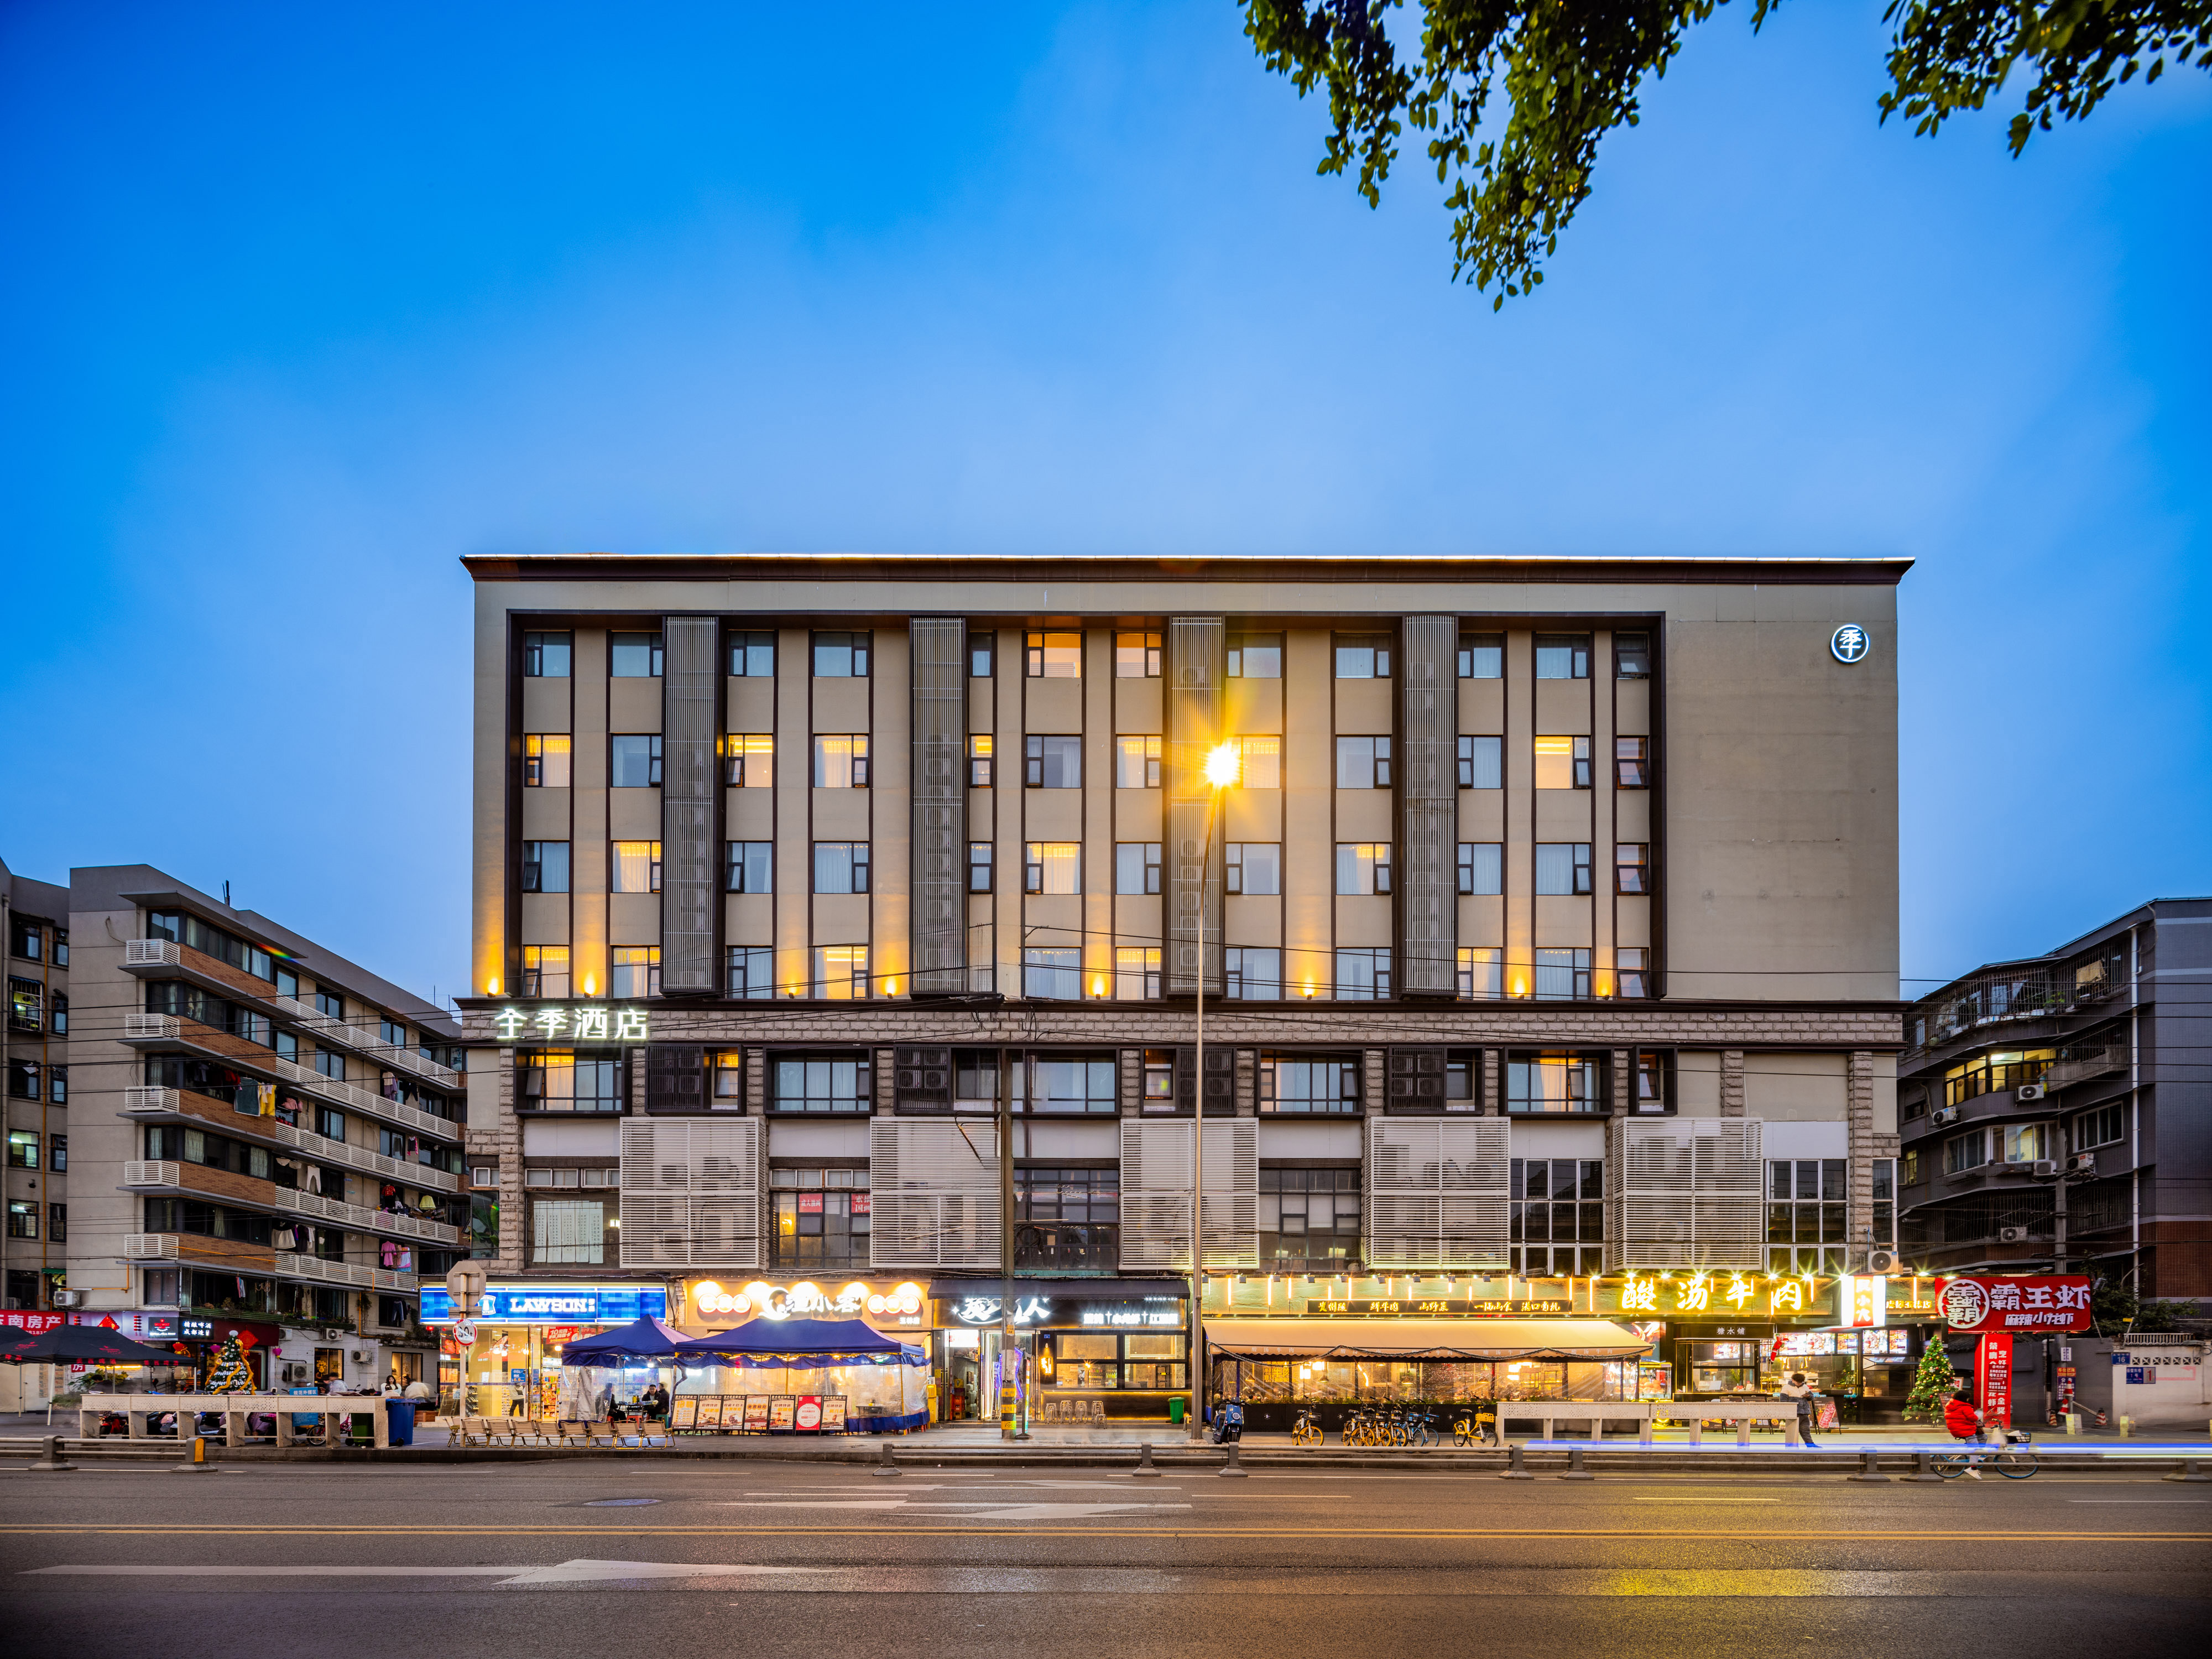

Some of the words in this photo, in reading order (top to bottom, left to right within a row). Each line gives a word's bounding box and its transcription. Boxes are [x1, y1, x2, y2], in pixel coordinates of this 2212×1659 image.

[1839, 629, 1863, 659] 季
[494, 1008, 648, 1039] 全季酒店
[510, 1298, 587, 1312] LAWSON
[1621, 1279, 1802, 1310] 酸汤牛肉
[1991, 1282, 2090, 1311] 霸王虾
[2005, 1312, 2074, 1326] 麻辣小龙虾
[2146, 1370, 2152, 1381] 1
